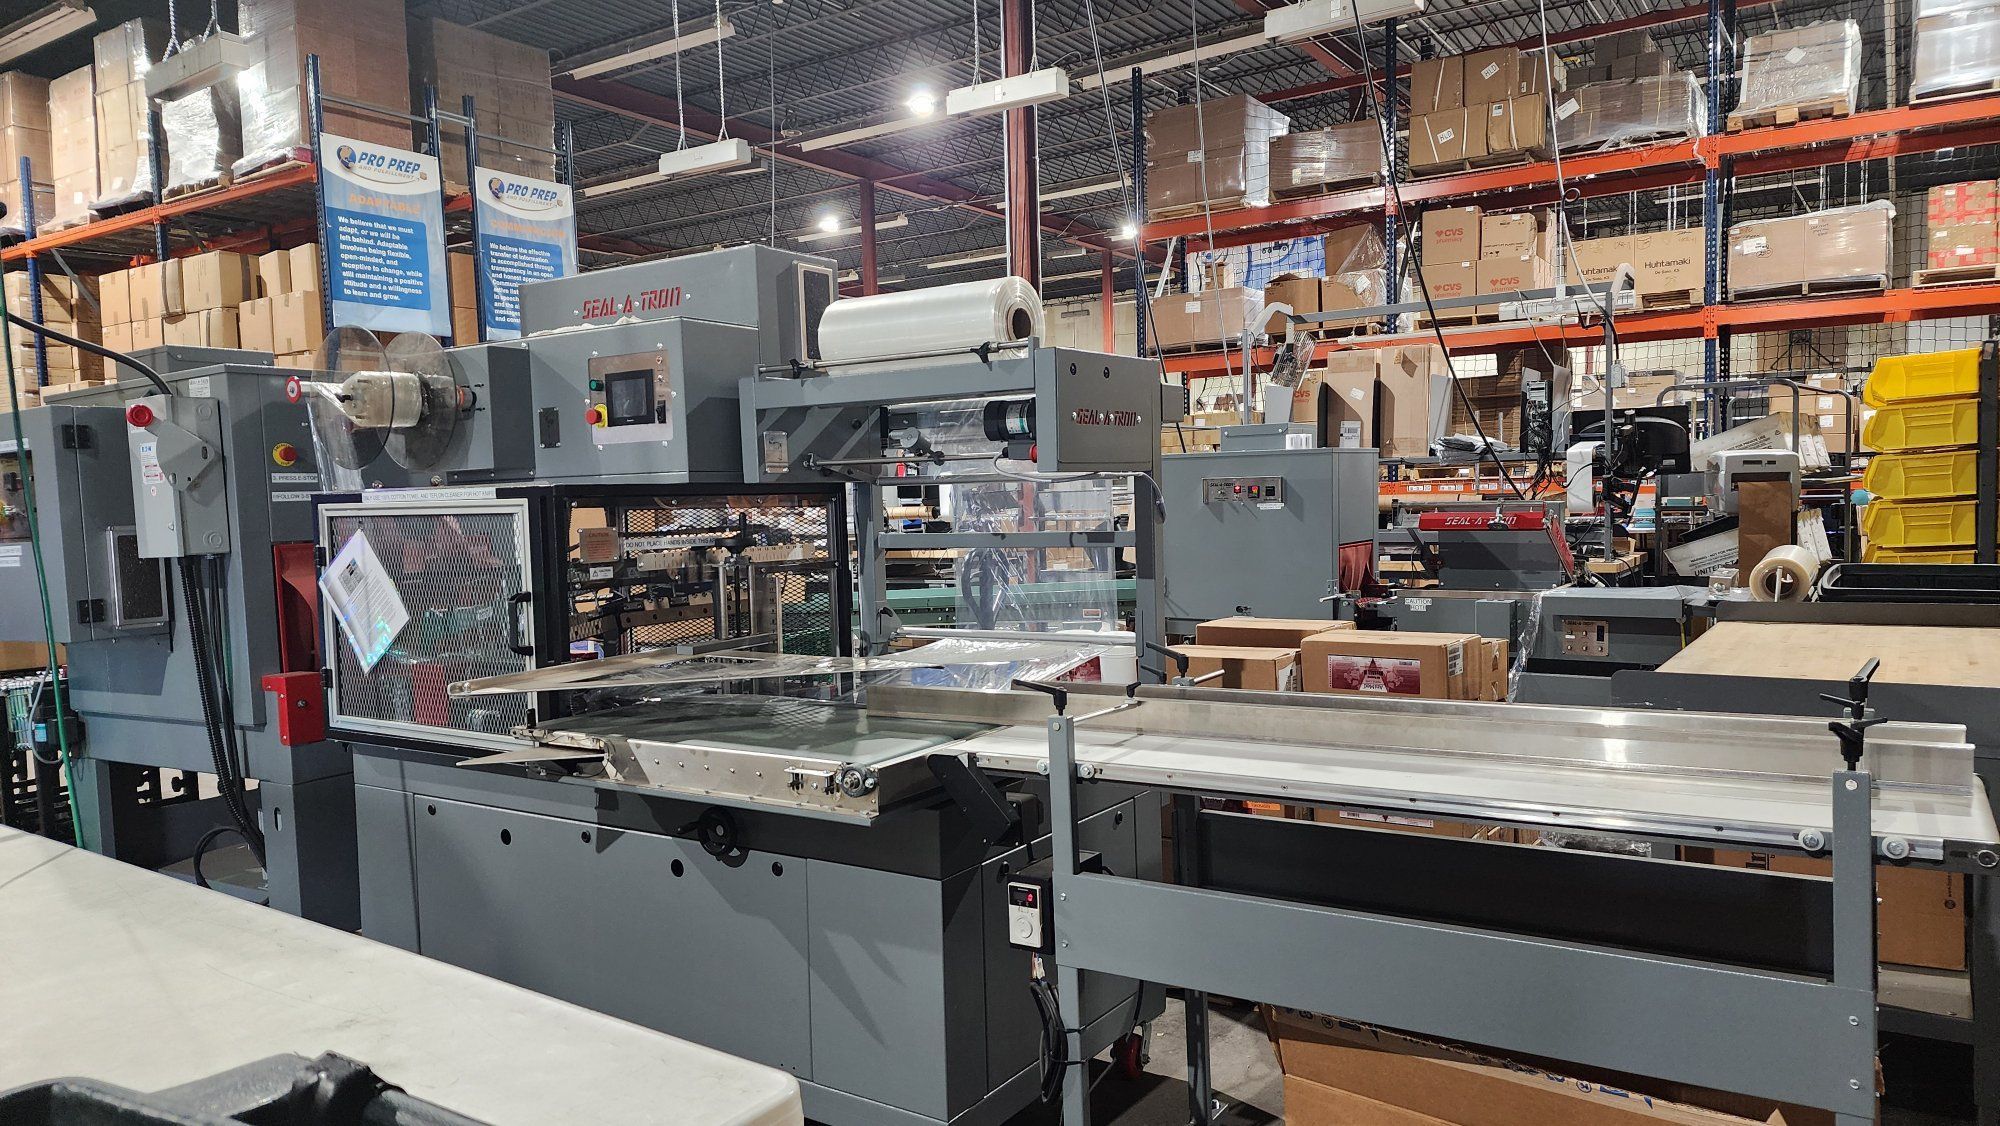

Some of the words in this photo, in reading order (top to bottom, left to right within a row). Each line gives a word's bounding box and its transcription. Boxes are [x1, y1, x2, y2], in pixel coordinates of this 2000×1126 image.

[1484, 64, 1498, 77] HLD
[1439, 130, 1452, 142] HLD
[358, 152, 385, 168] PRO
[387, 158, 420, 174] PREP
[374, 168, 414, 180] FULFILLMENT
[506, 183, 528, 197] PRO
[530, 188, 558, 202] PREP
[338, 216, 348, 224] We
[350, 218, 372, 227] believe
[374, 222, 387, 230] that
[398, 226, 414, 234] must
[338, 225, 360, 235] adapt,
[1444, 228, 1464, 237] CVS
[340, 234, 351, 242] left
[352, 235, 376, 245] behind.
[377, 240, 408, 250] Adaptable
[368, 246, 386, 256] being
[387, 249, 412, 260] flexible,
[500, 244, 518, 252] believe
[528, 248, 550, 256] effective
[340, 253, 385, 264] open-minded,
[490, 250, 512, 258] transfer
[519, 254, 549, 264] information
[1644, 257, 1690, 269] Huhtamaki
[342, 262, 372, 271] receptive
[380, 266, 406, 276] change,
[490, 264, 526, 276] transparency
[498, 258, 534, 268] accomplished
[534, 264, 554, 272] through
[356, 272, 393, 284] maintaining
[400, 278, 424, 286] positive
[492, 279, 518, 288] Communi
[1500, 276, 1520, 286] CVS
[344, 280, 368, 288] attitude
[388, 285, 422, 294] willingness
[352, 288, 368, 297] learn
[1442, 283, 1462, 292] CVS
